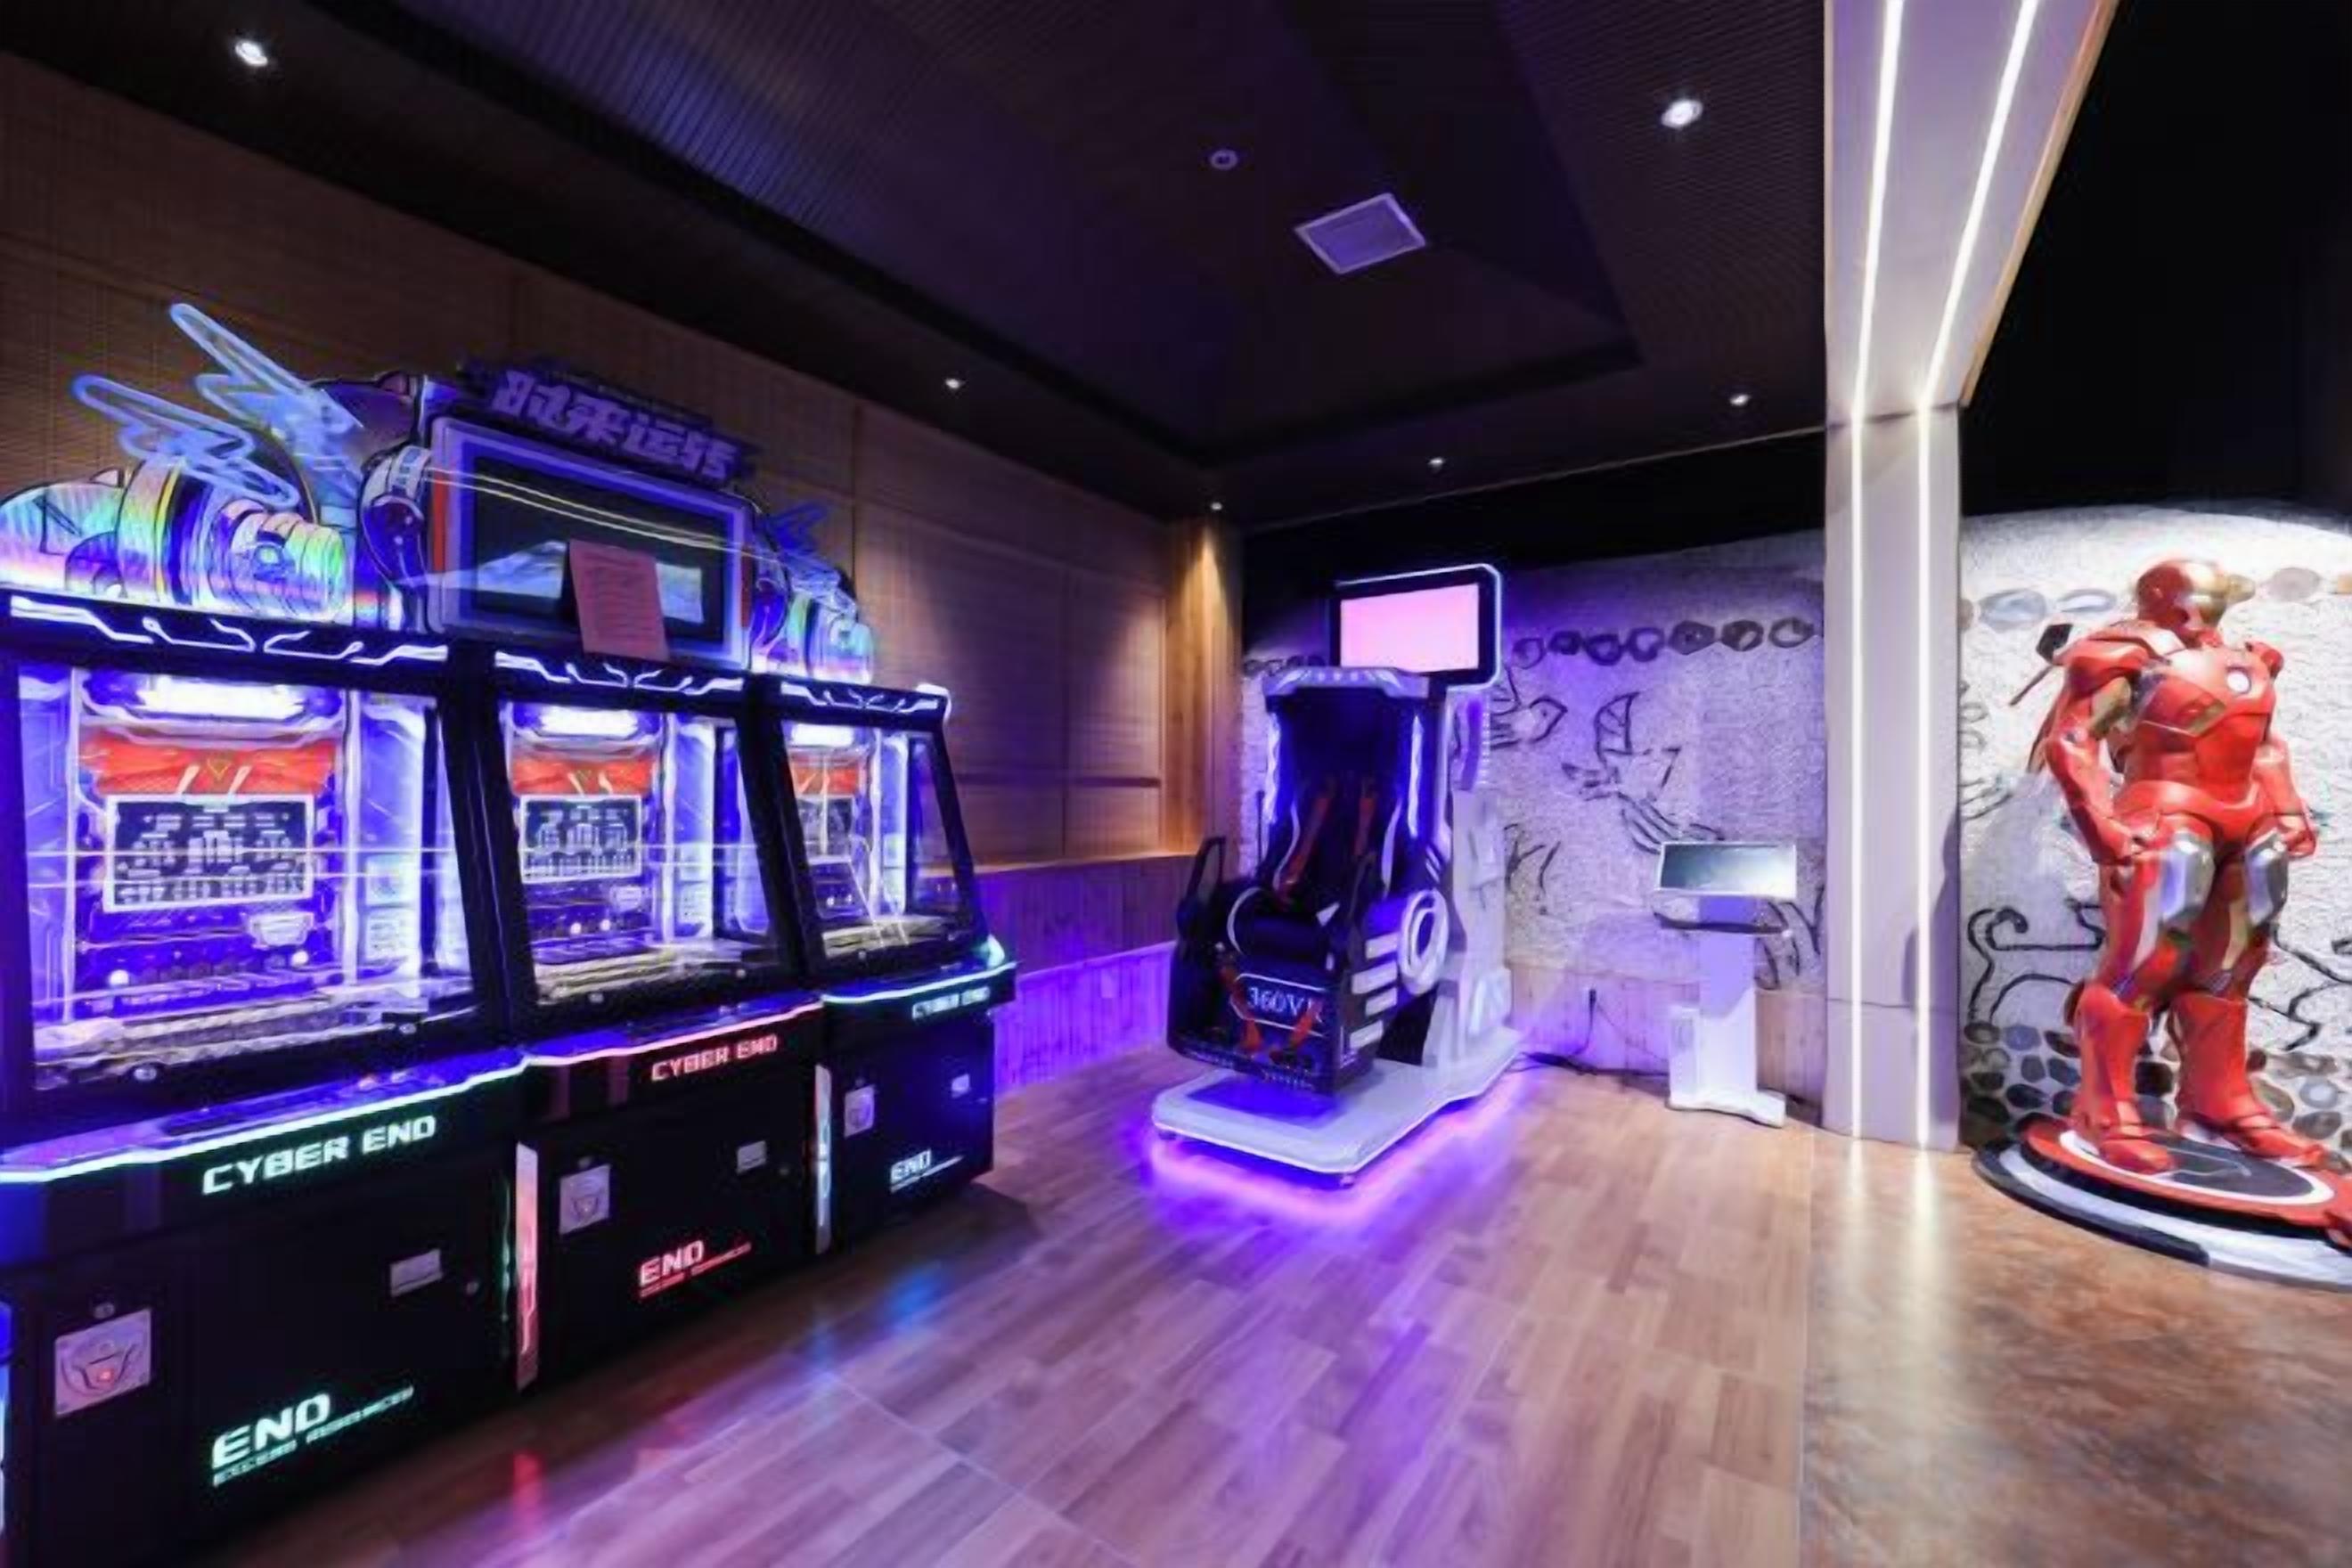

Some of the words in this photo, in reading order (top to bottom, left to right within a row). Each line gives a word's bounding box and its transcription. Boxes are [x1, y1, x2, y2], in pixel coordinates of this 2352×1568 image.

[651, 1045, 730, 1081] CYBER
[737, 1033, 778, 1059] END
[202, 1136, 350, 1195] CYBER
[362, 1115, 437, 1154] END
[641, 1240, 704, 1286] END
[212, 1392, 331, 1469] END
